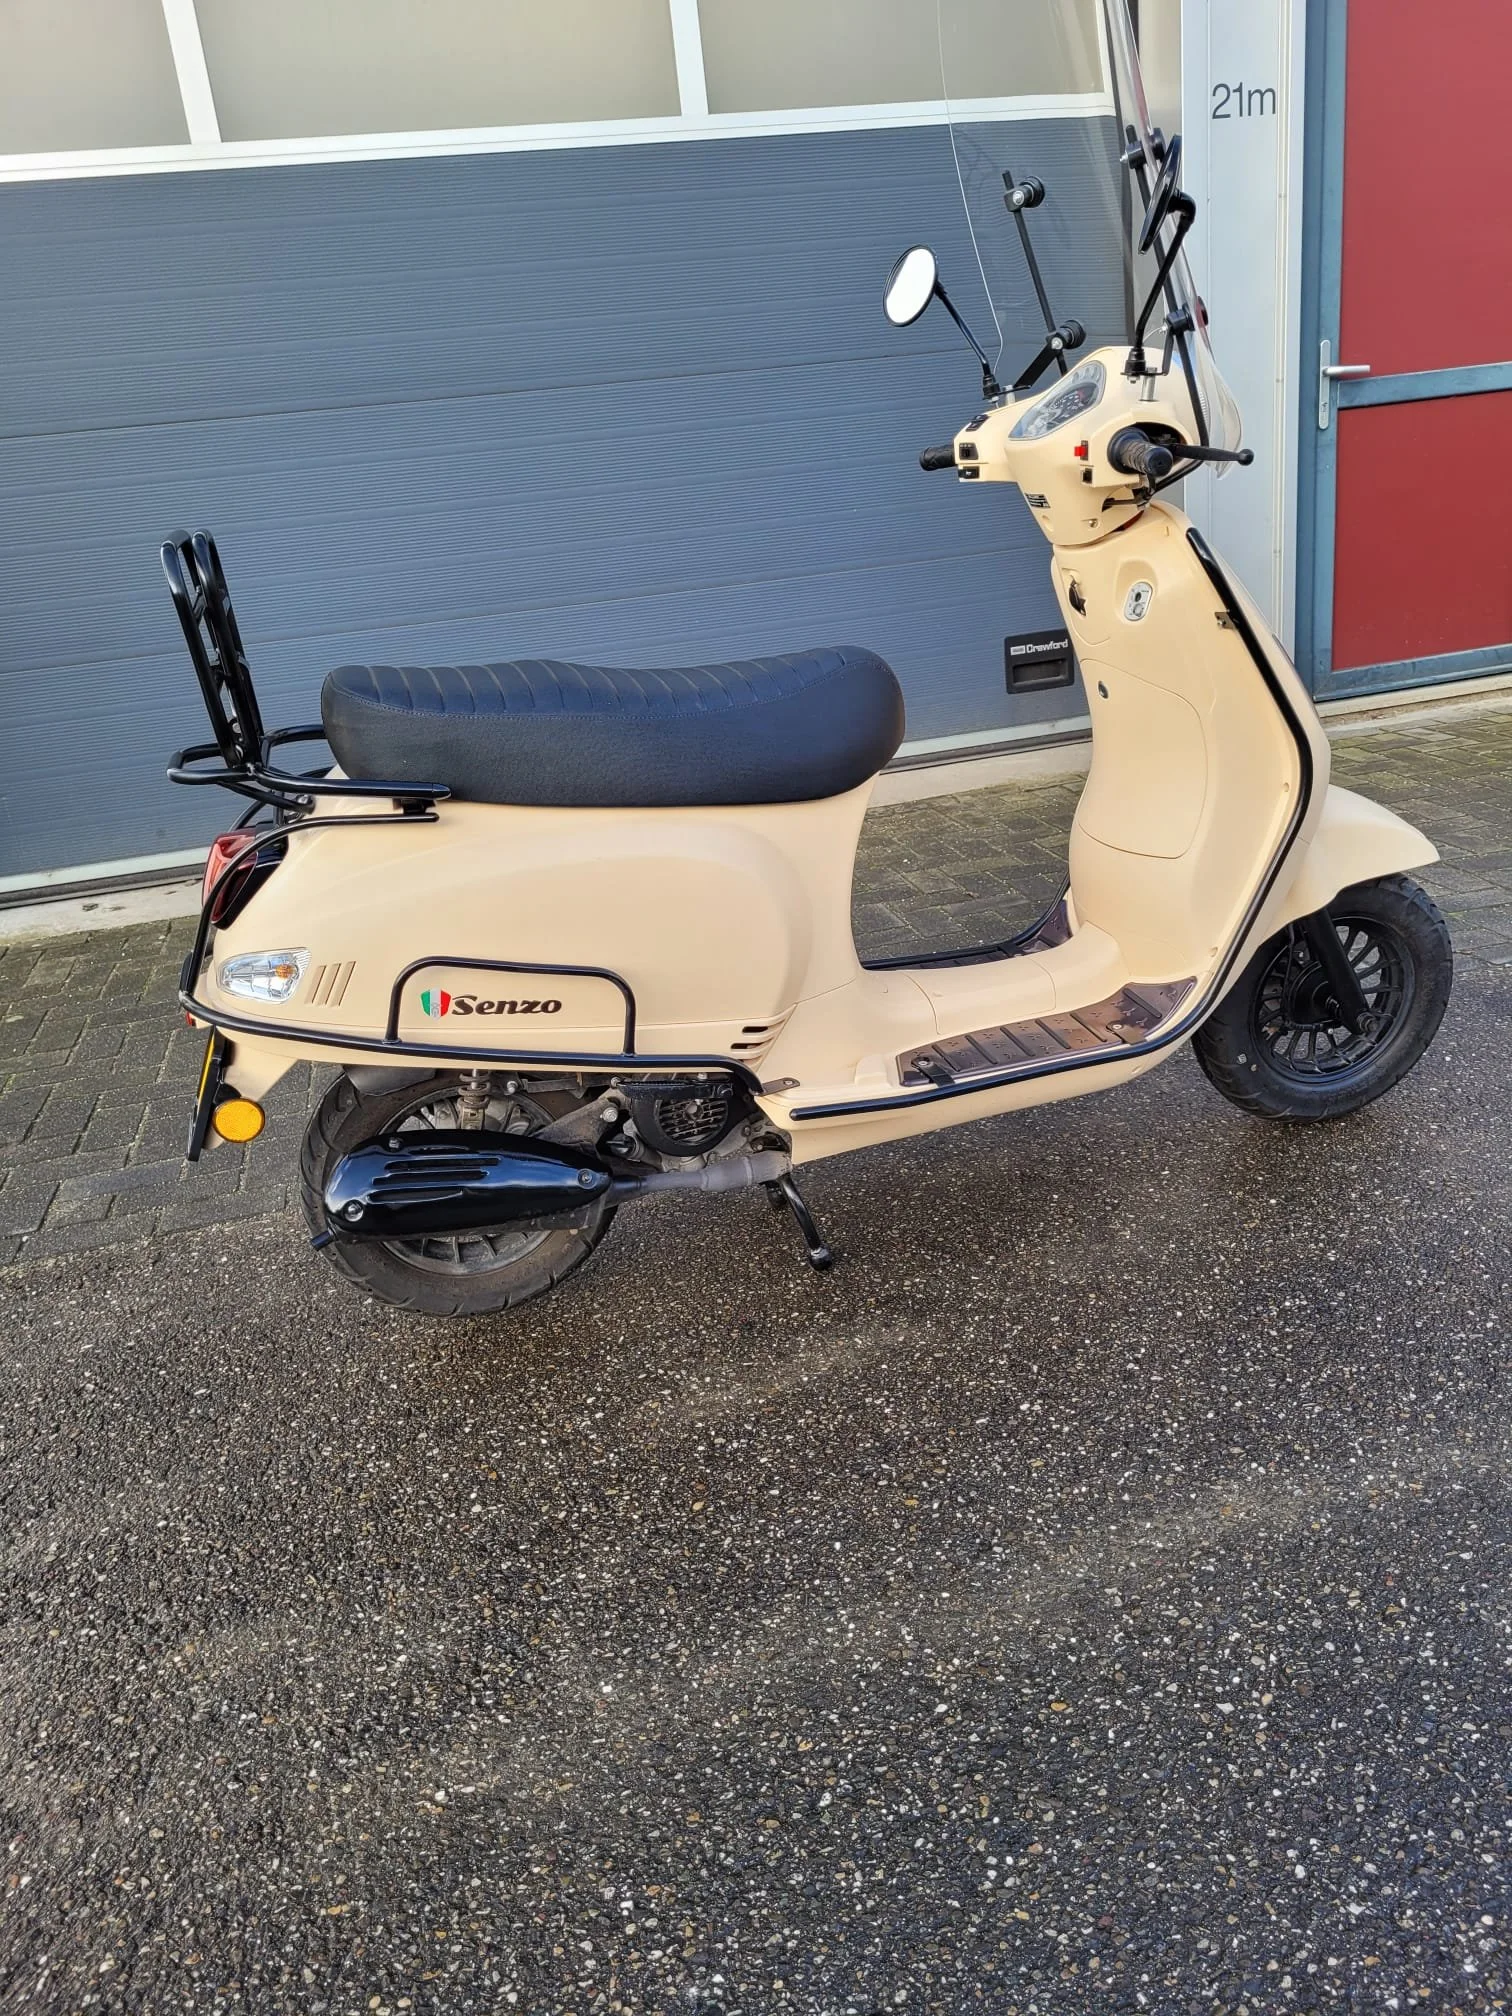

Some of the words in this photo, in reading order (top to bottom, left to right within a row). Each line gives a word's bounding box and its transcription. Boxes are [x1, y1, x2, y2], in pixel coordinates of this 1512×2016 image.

[1212, 82, 1276, 119] 21m
[1026, 639, 1069, 654] Crawford
[451, 994, 562, 1016] Senzo
